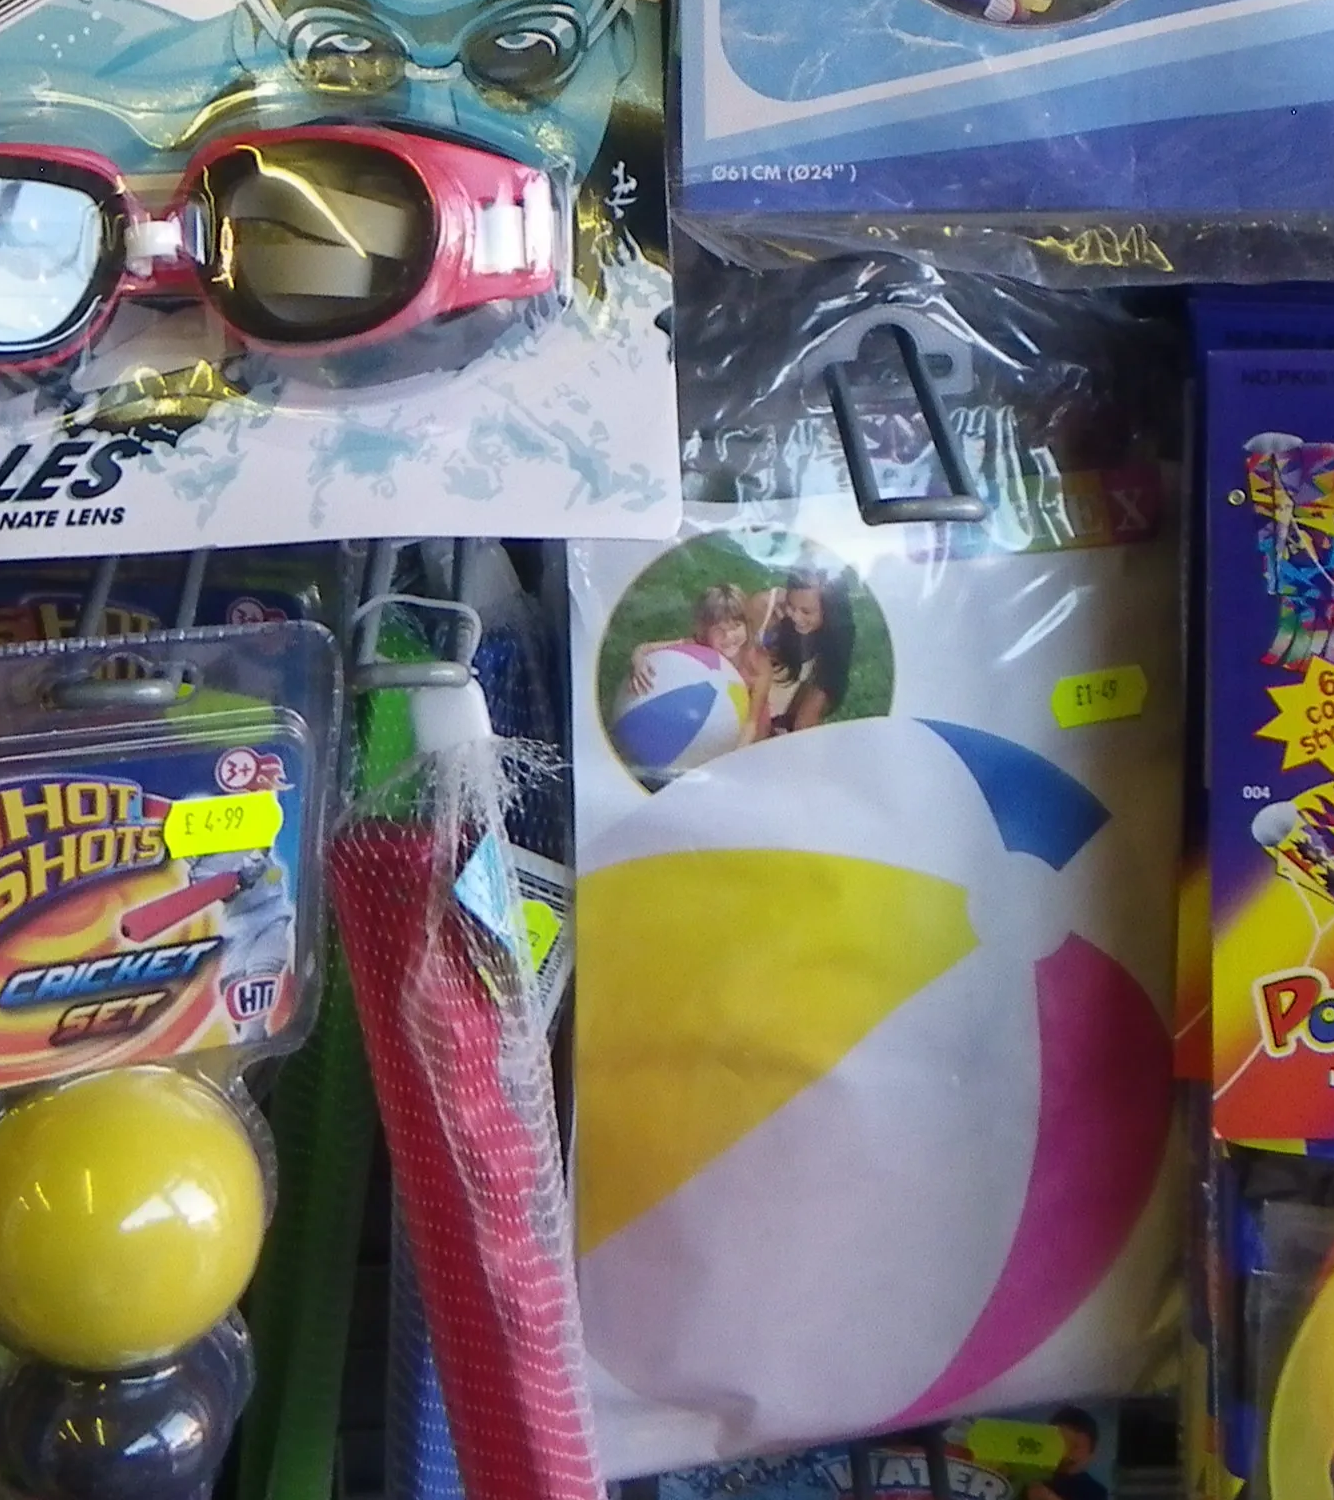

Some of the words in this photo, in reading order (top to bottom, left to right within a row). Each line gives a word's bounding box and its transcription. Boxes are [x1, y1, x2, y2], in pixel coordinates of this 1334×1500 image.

[65, 505, 125, 530] LENS
[1, 781, 144, 841] HOT
[1242, 785, 1272, 800] 004
[51, 992, 171, 1045] SET
